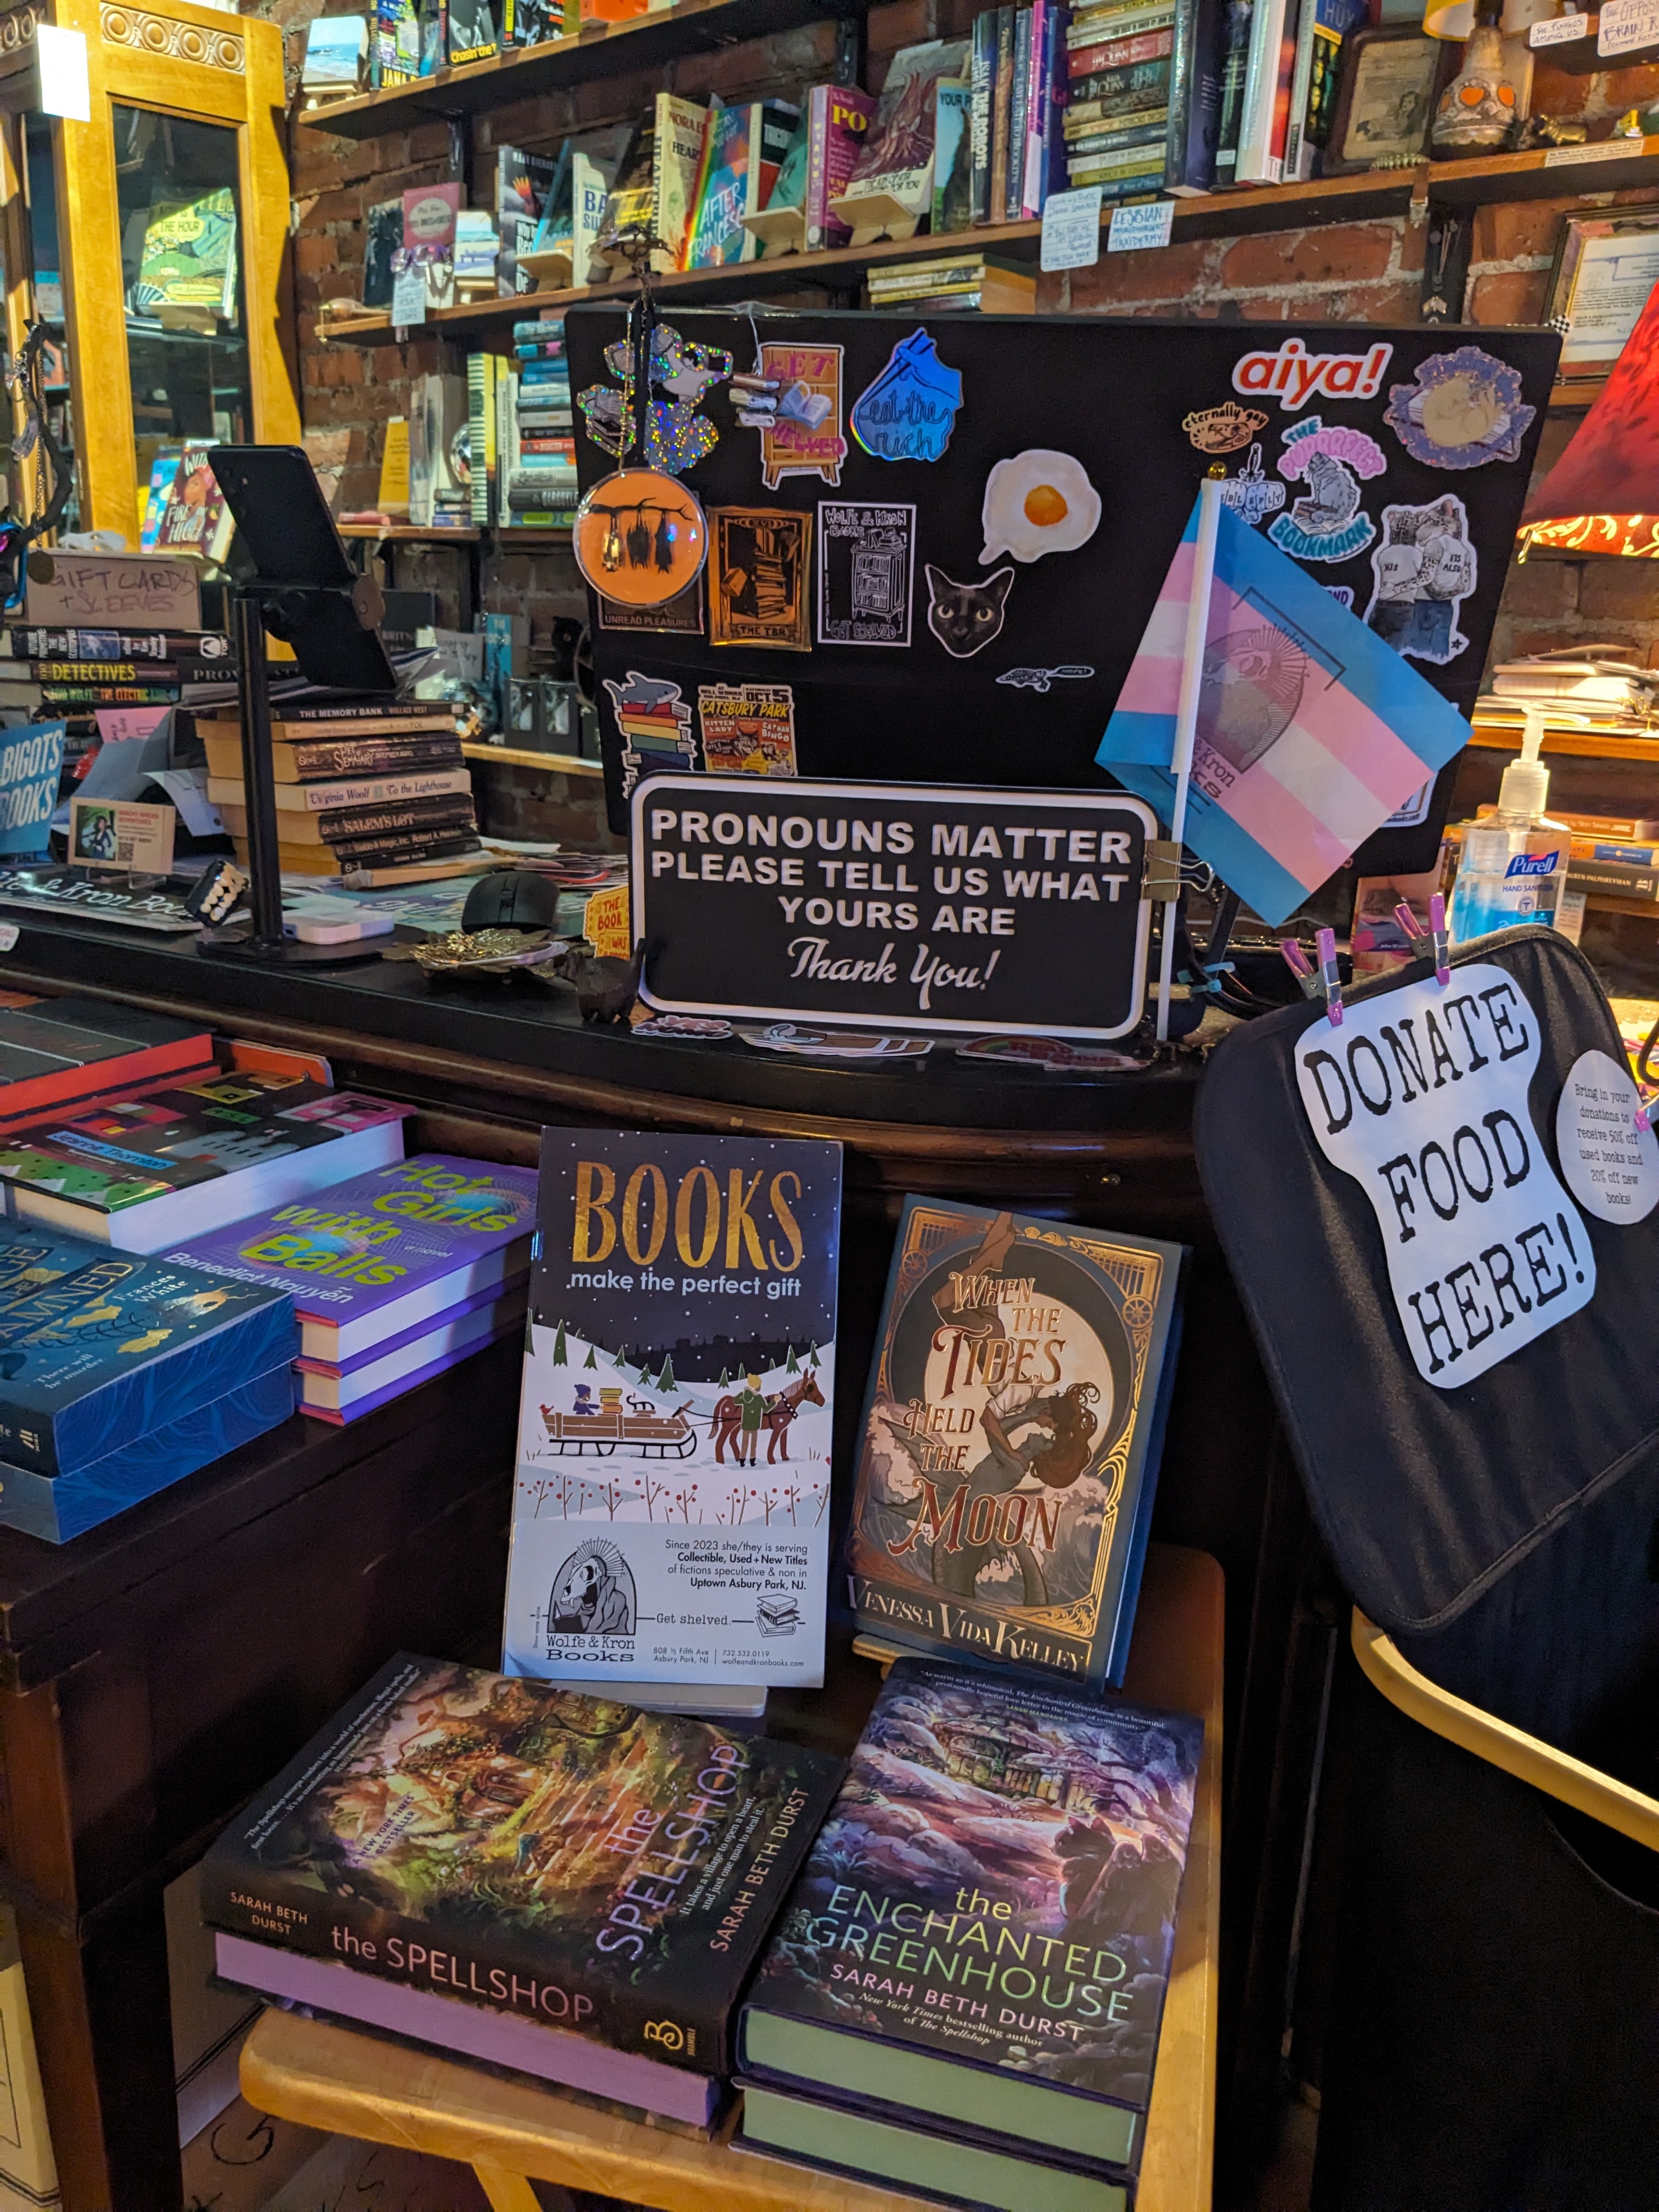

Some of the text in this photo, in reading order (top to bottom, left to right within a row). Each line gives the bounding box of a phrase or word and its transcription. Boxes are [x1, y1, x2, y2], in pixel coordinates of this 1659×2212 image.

[1550, 19, 1583, 31] FUNGUS
[1605, 18, 1644, 42] BRAIN
[700, 183, 743, 231] AFTER
[1113, 206, 1163, 226] LESBIAN
[178, 221, 200, 232] HOUR
[1239, 344, 1386, 405] aiya!
[1185, 404, 1241, 428] eternally
[1271, 515, 1373, 557] BOOKMARK
[118, 569, 197, 595] CARDS
[605, 615, 696, 628] UNREAD PLEASURES
[53, 664, 136, 681] DETECTIVES
[701, 701, 790, 718] CATSBURY PARK
[772, 689, 789, 703] 5
[319, 708, 382, 718] MEMORY BANK
[0, 730, 63, 786] BIGOTS
[347, 788, 369, 799] Woolf
[415, 781, 452, 793] Lighthouse
[652, 810, 1131, 865] PRONOUNS MATTER
[652, 850, 1130, 902] PLEASE TELL US WHAT
[1512, 857, 1554, 873] Purell
[598, 912, 622, 928] BOOK
[603, 898, 620, 911] THE
[778, 896, 1015, 936] YOURS ARE
[787, 936, 1001, 1010] Thank You!
[1304, 983, 1529, 1135] DONATE
[1575, 1084, 1630, 1103] Bring your
[1581, 1106, 1629, 1123] donations to
[54, 1131, 174, 1170] Jeanne Thornton
[1577, 1128, 1638, 1144] receive 50% off
[1579, 1149, 1643, 1165] used books and
[377, 1160, 493, 1194] Hot
[1378, 1110, 1530, 1243] FOOD
[1608, 1172, 1638, 1185] off new
[271, 1205, 402, 1245] with
[373, 1191, 517, 1232] Girls
[572, 1161, 803, 1272] BOOKS
[163, 1252, 265, 1286] Benedict
[240, 1234, 407, 1285] Balls
[111, 1274, 176, 1301] Frances
[133, 1280, 188, 1303] White
[571, 1271, 802, 1300] make the perfect gift
[949, 1271, 1035, 1314] WHEN
[1409, 1213, 1584, 1374] HERE!
[1012, 1306, 1062, 1334] THE
[932, 1323, 1067, 1399] TIDES
[903, 1399, 975, 1438] HELD
[921, 1444, 970, 1472] THE
[887, 1477, 1064, 1554] MOON
[665, 1539, 808, 1555] Since 2023 she/they is serving
[678, 1551, 808, 1565] Collectible, Used New Titles
[668, 1564, 677, 1573] of
[680, 1564, 712, 1575] fictions
[714, 1566, 765, 1577] speculative
[799, 1568, 807, 1578] in
[690, 1577, 806, 1591] Uptown Asbury Park, NJ.
[656, 1613, 732, 1626] Get shelved.
[848, 1574, 1088, 1673] VENESSA VIDA KELLEY
[546, 1635, 635, 1649] Wolfe & Kron
[546, 1649, 634, 1662] Books
[653, 1656, 677, 1664] Asbury
[722, 1657, 804, 1667] wolfeandkronbooks.com
[375, 1810, 417, 1854] BESTSELLER
[604, 1807, 660, 1855] the
[596, 1743, 752, 1961] SPELLSHOP
[685, 1824, 738, 1906] takes village open
[721, 1843, 744, 1876] one man
[710, 1787, 809, 1951] SARAH BETH DURST
[230, 1891, 308, 1924] SARAH BETH
[956, 1885, 1012, 1921] the
[251, 1915, 291, 1935] DURST
[827, 1883, 1126, 1983] ENCHANTED
[331, 1925, 594, 2023] the SPELLSHOP
[806, 1917, 1135, 2024] GREENHOUSE
[831, 1962, 1086, 2042] SARAH BETH DURST
[858, 1992, 1043, 2047] New York Times bestselling author
[940, 2025, 990, 2046] Spellshop
